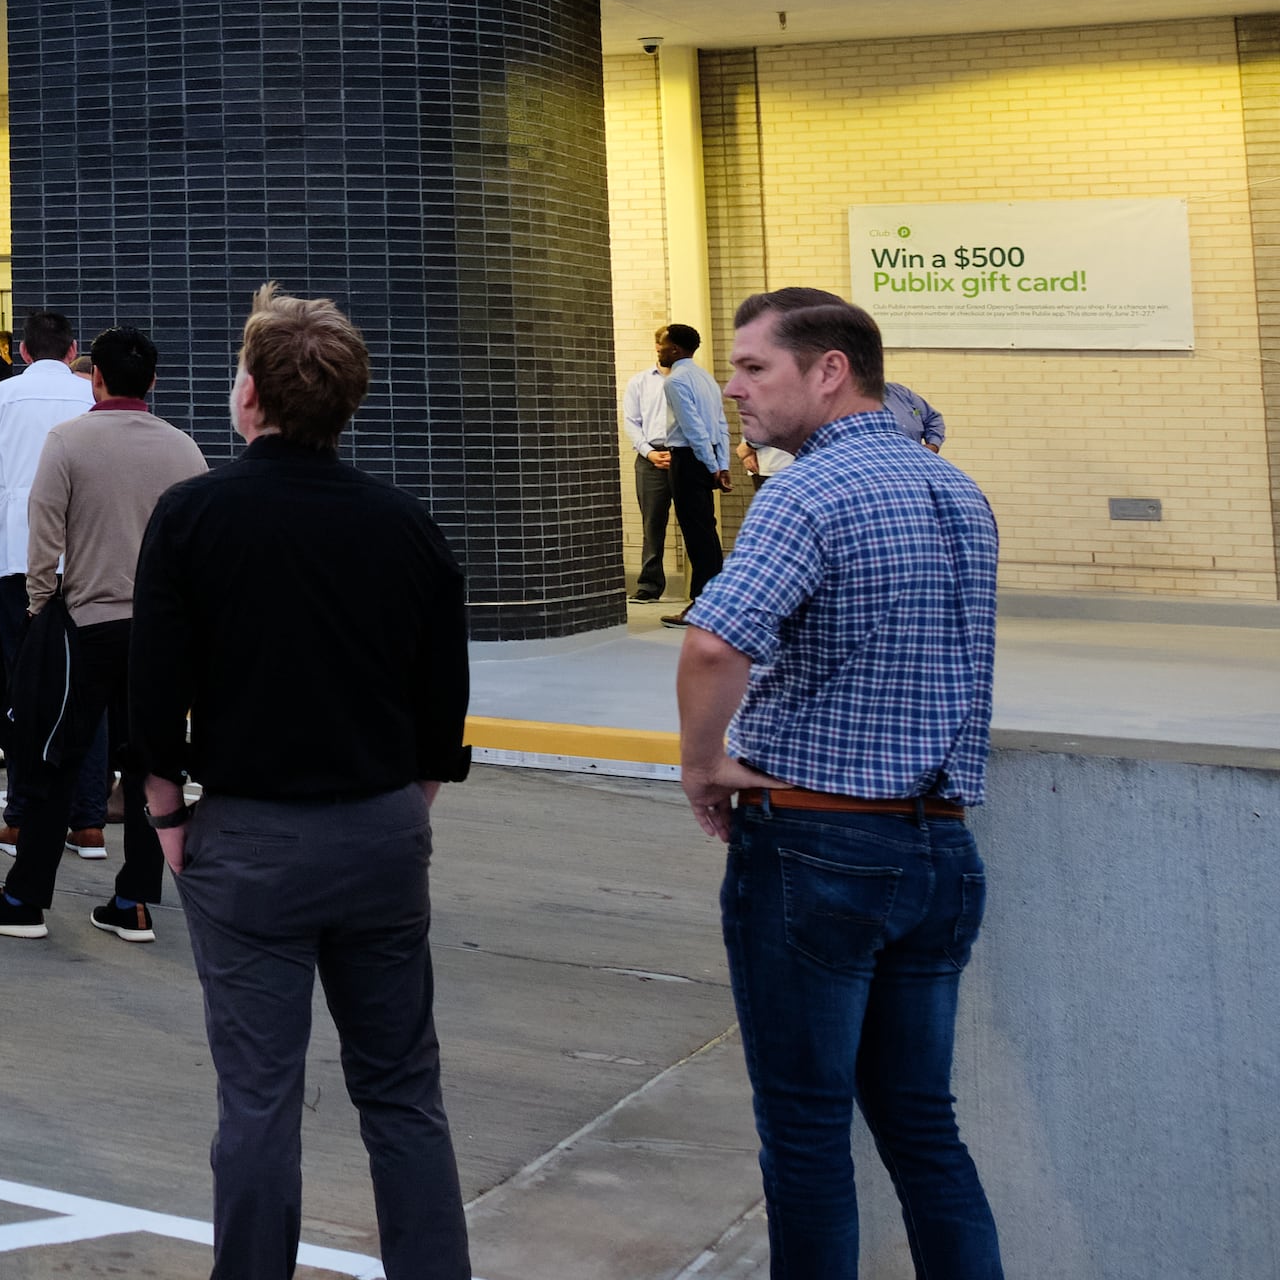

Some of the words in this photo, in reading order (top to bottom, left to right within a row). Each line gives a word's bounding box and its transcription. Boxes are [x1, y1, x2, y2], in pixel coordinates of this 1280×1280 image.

[871, 247, 924, 268] Win
[931, 254, 946, 268] a
[954, 245, 1025, 270] $500
[873, 271, 955, 292] Publix
[961, 271, 1011, 298] gift
[1017, 271, 1087, 292] card!
